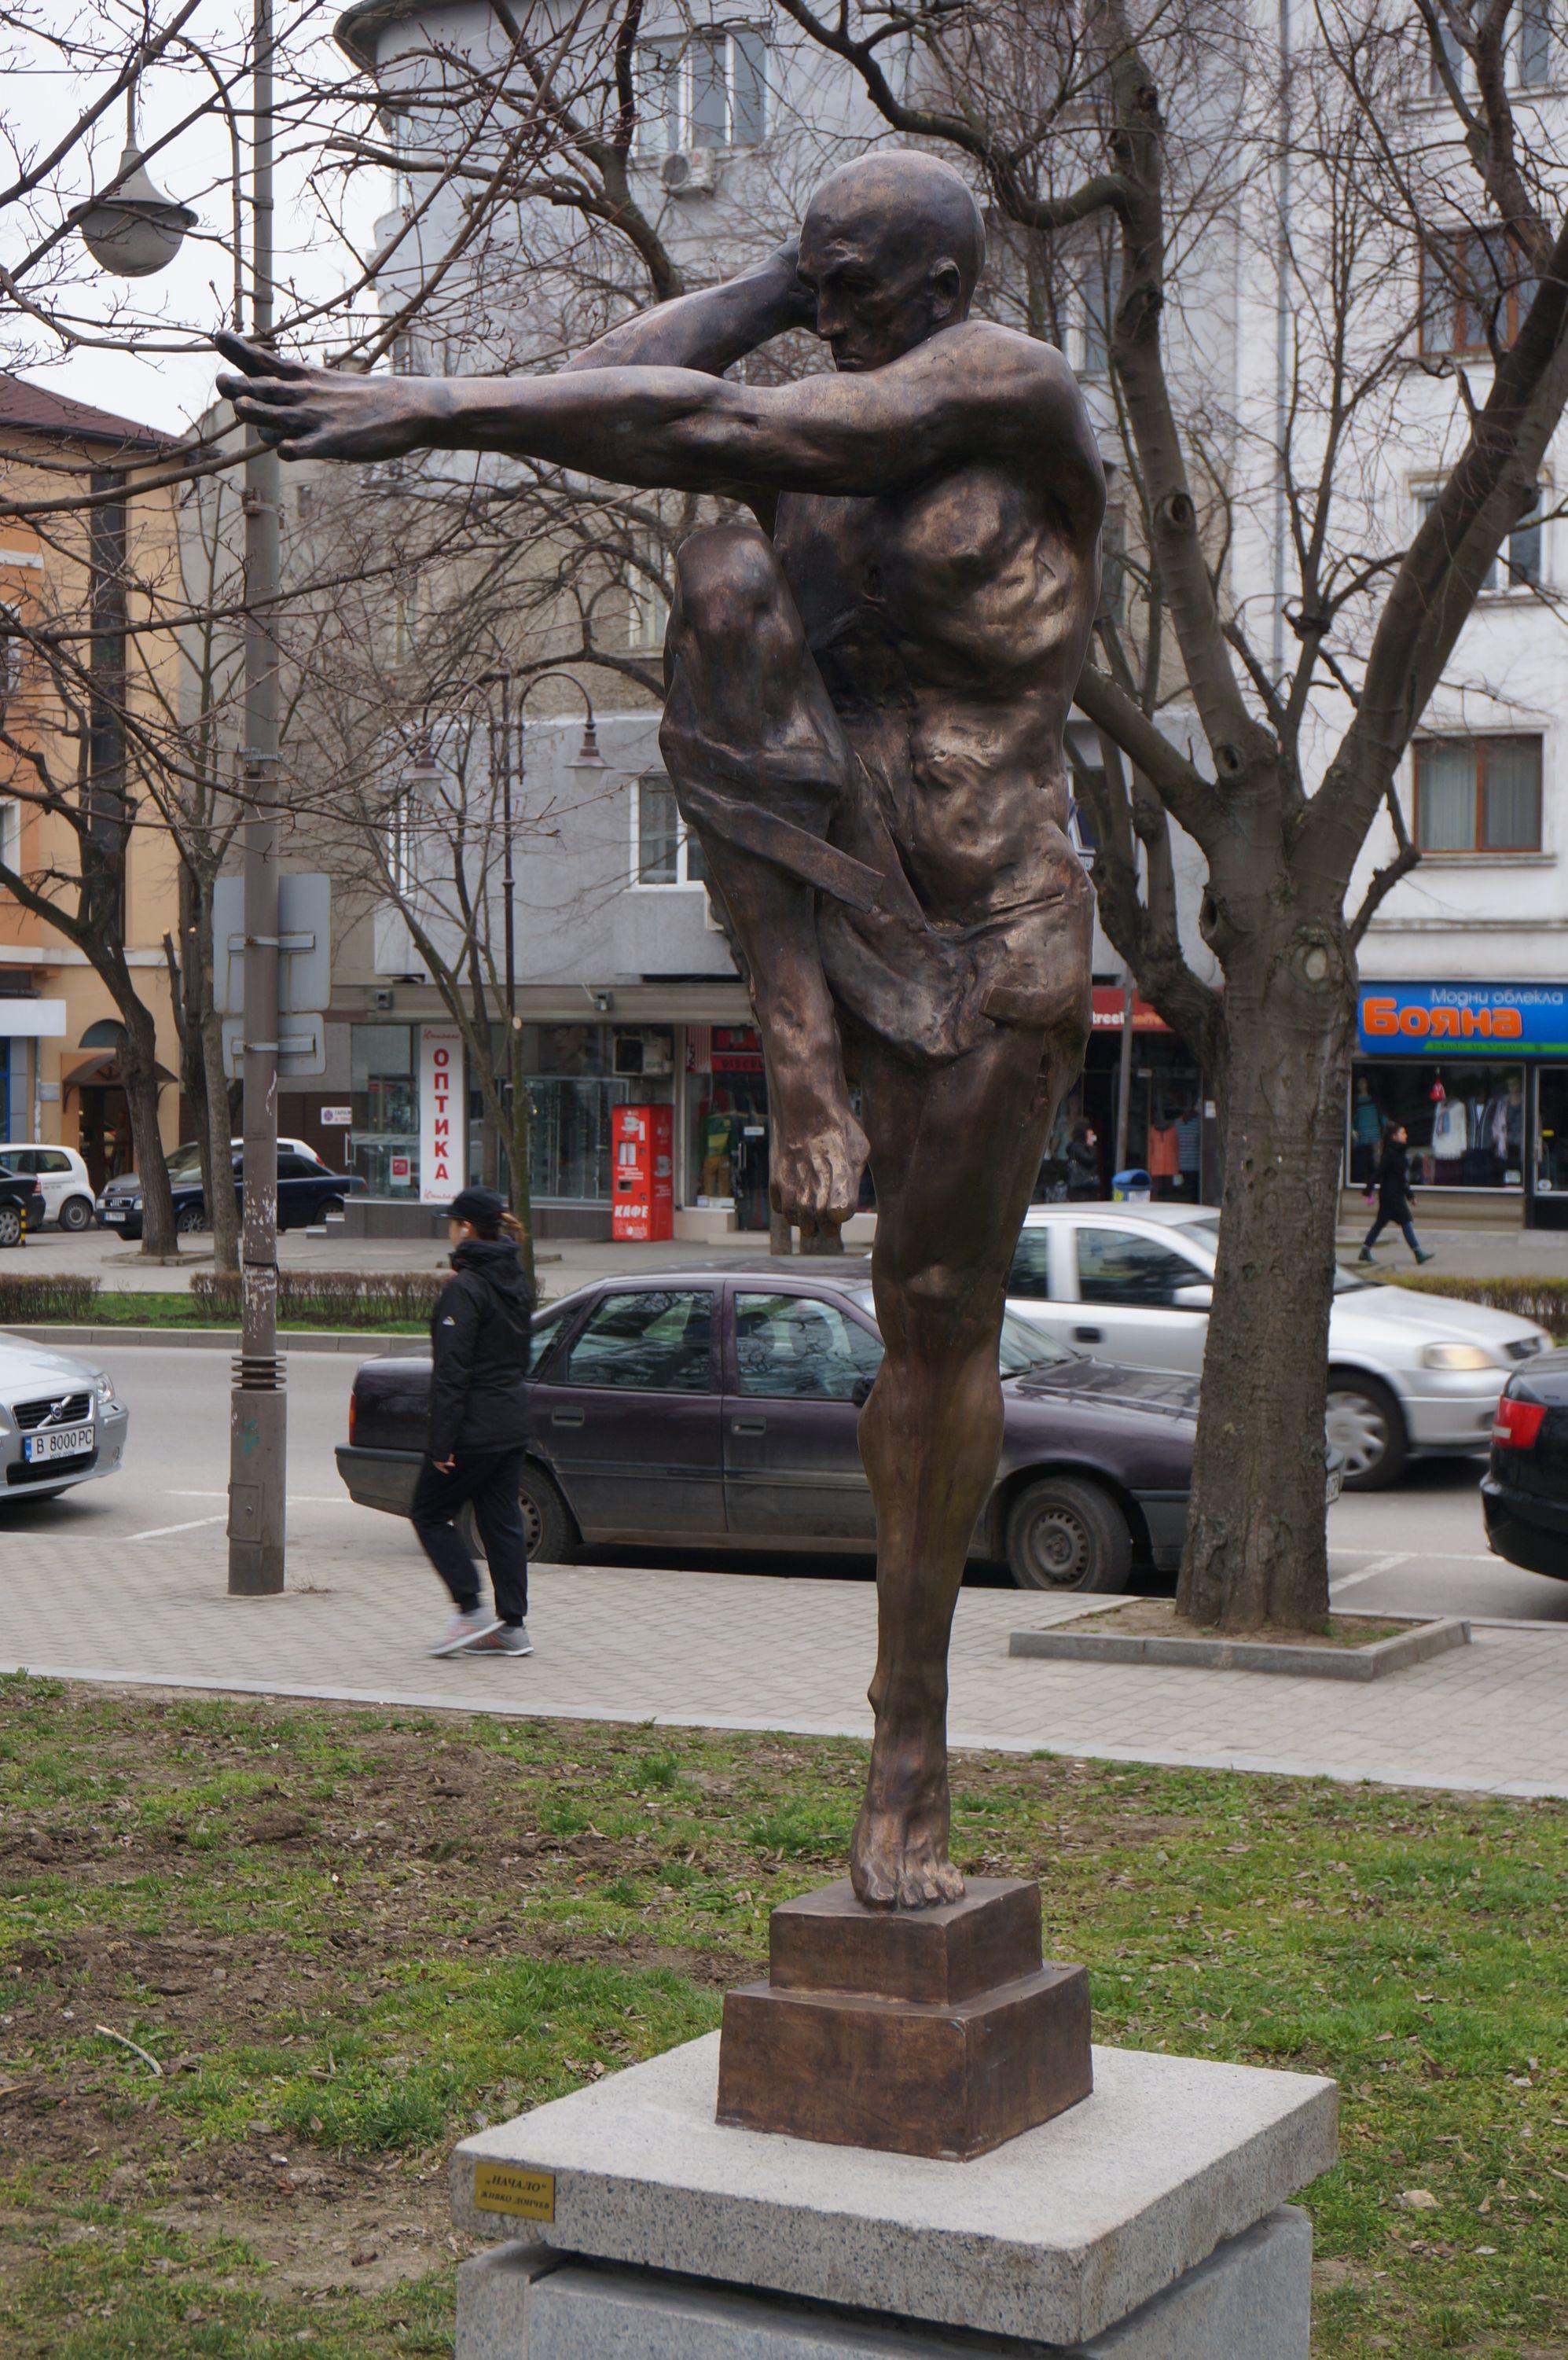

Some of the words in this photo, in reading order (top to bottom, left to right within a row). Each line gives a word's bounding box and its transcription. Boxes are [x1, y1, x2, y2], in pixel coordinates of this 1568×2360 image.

[1431, 988, 1488, 1007] Модни
[1493, 988, 1564, 1005] облекла
[1363, 997, 1522, 1038] Бояна
[433, 1048, 450, 1181] ОПТИКА
[614, 1205, 649, 1219] КАФЕ
[36, 1438, 44, 1454] B
[50, 1432, 77, 1451] 8000
[78, 1429, 93, 1447] PC
